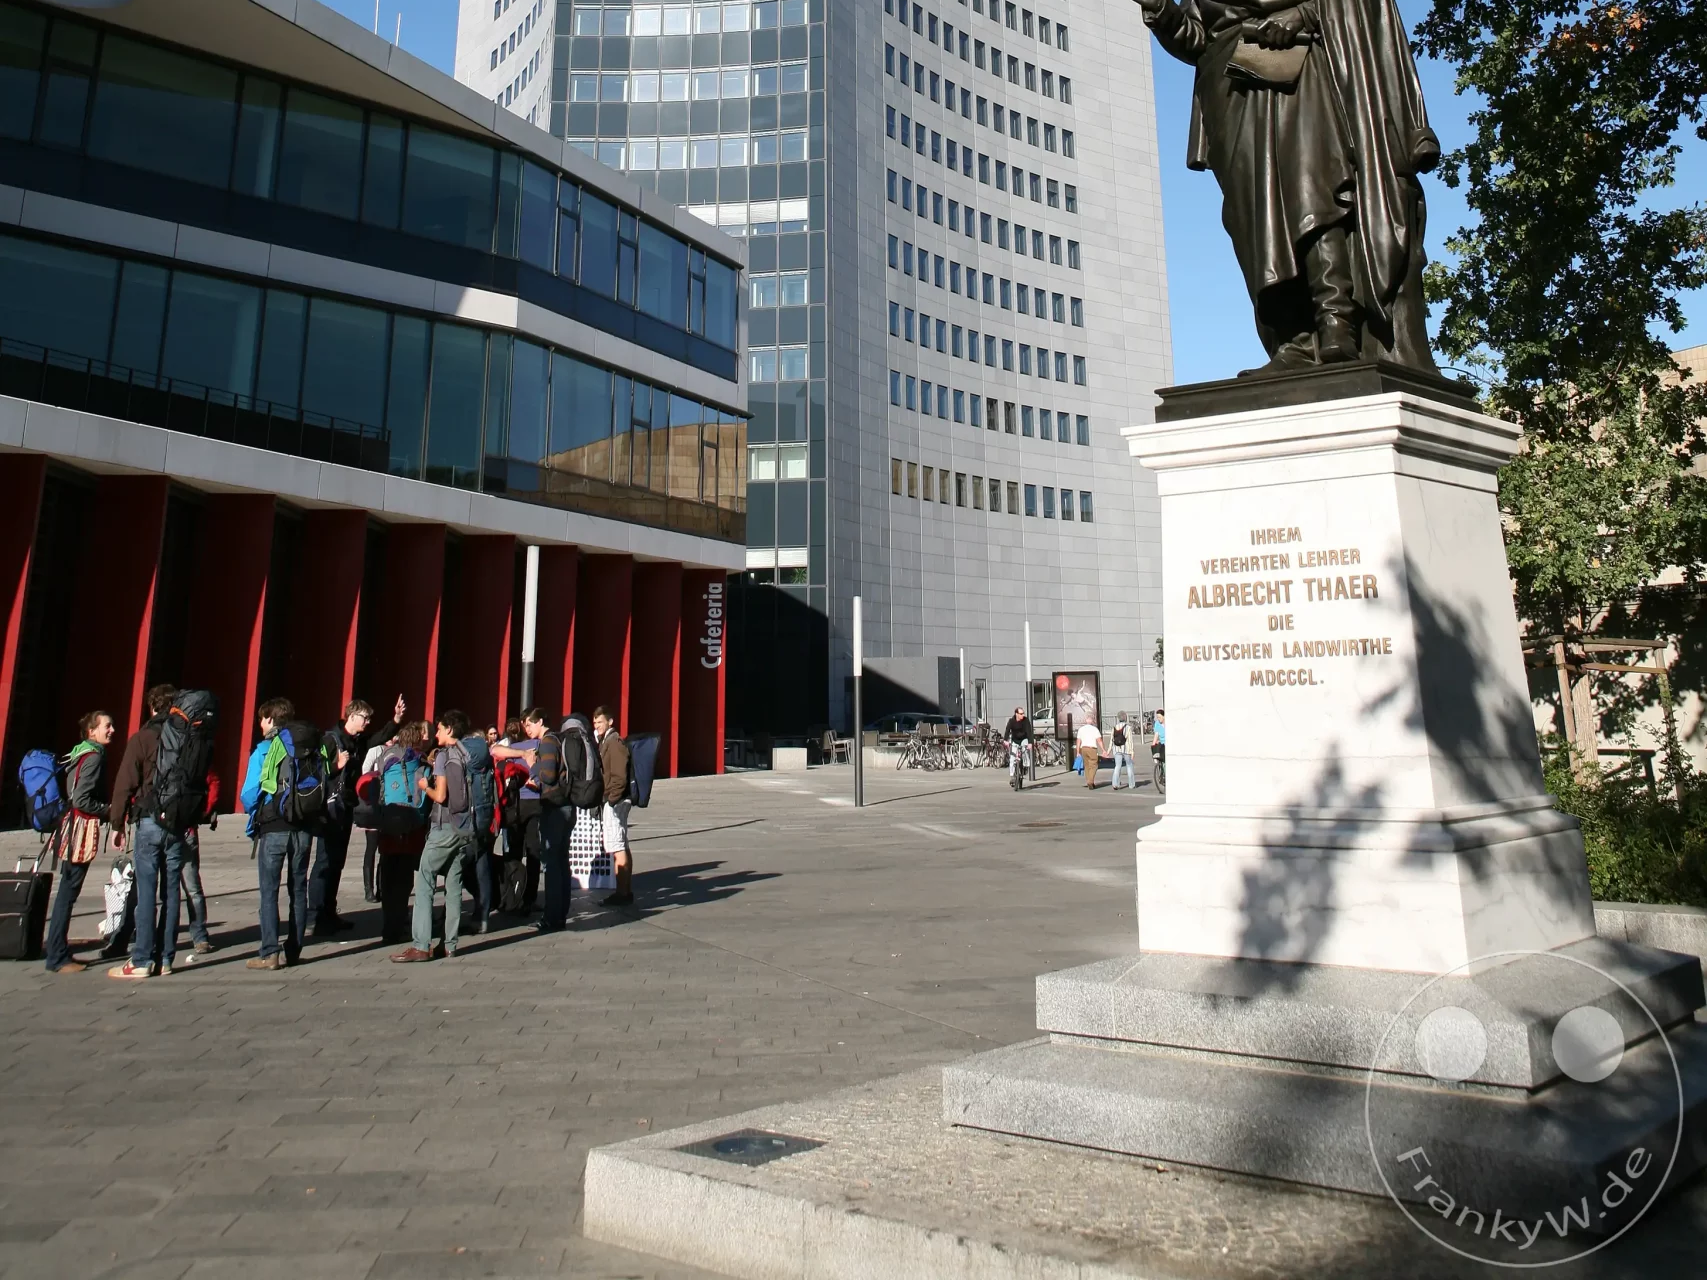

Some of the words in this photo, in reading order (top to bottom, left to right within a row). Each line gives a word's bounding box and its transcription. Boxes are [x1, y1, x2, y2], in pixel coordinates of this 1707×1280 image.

[1251, 527, 1302, 545] IHREM
[1201, 553, 1290, 574] VEREHRTEN
[1299, 548, 1360, 567] LEHRER
[1188, 580, 1293, 608] ALBRECHT
[1303, 575, 1378, 601] THAER
[700, 583, 722, 669] Cafeteria
[1268, 614, 1294, 631] DIE
[1183, 643, 1272, 661] DEUTSCHEN
[1283, 637, 1392, 658] LANDWIRTHE
[1250, 669, 1324, 686] MDCCCL.
